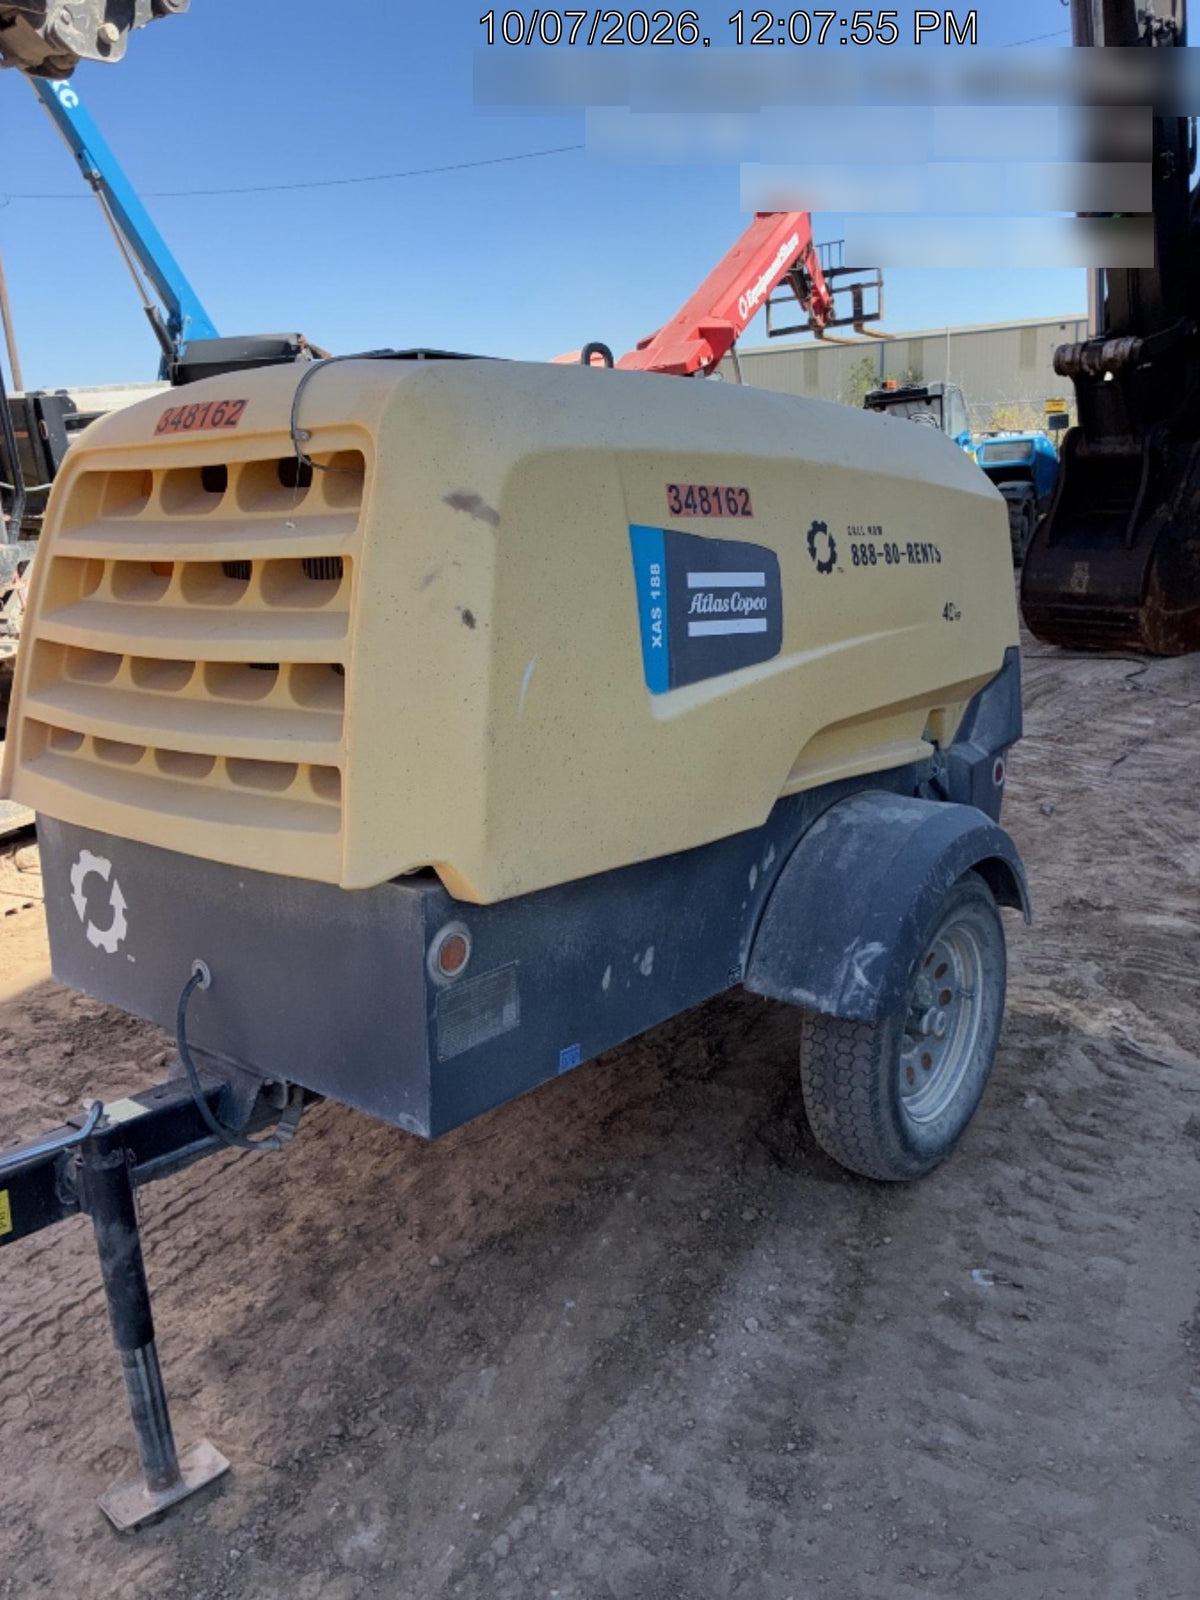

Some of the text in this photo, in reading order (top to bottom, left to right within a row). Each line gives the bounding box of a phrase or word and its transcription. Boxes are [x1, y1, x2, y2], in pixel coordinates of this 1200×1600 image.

[156, 399, 247, 433] 348162
[667, 484, 752, 516] 348162
[850, 542, 942, 566] 888-80-RENTS
[687, 591, 768, 616] Atlas Copco
[651, 607, 663, 649] XAS
